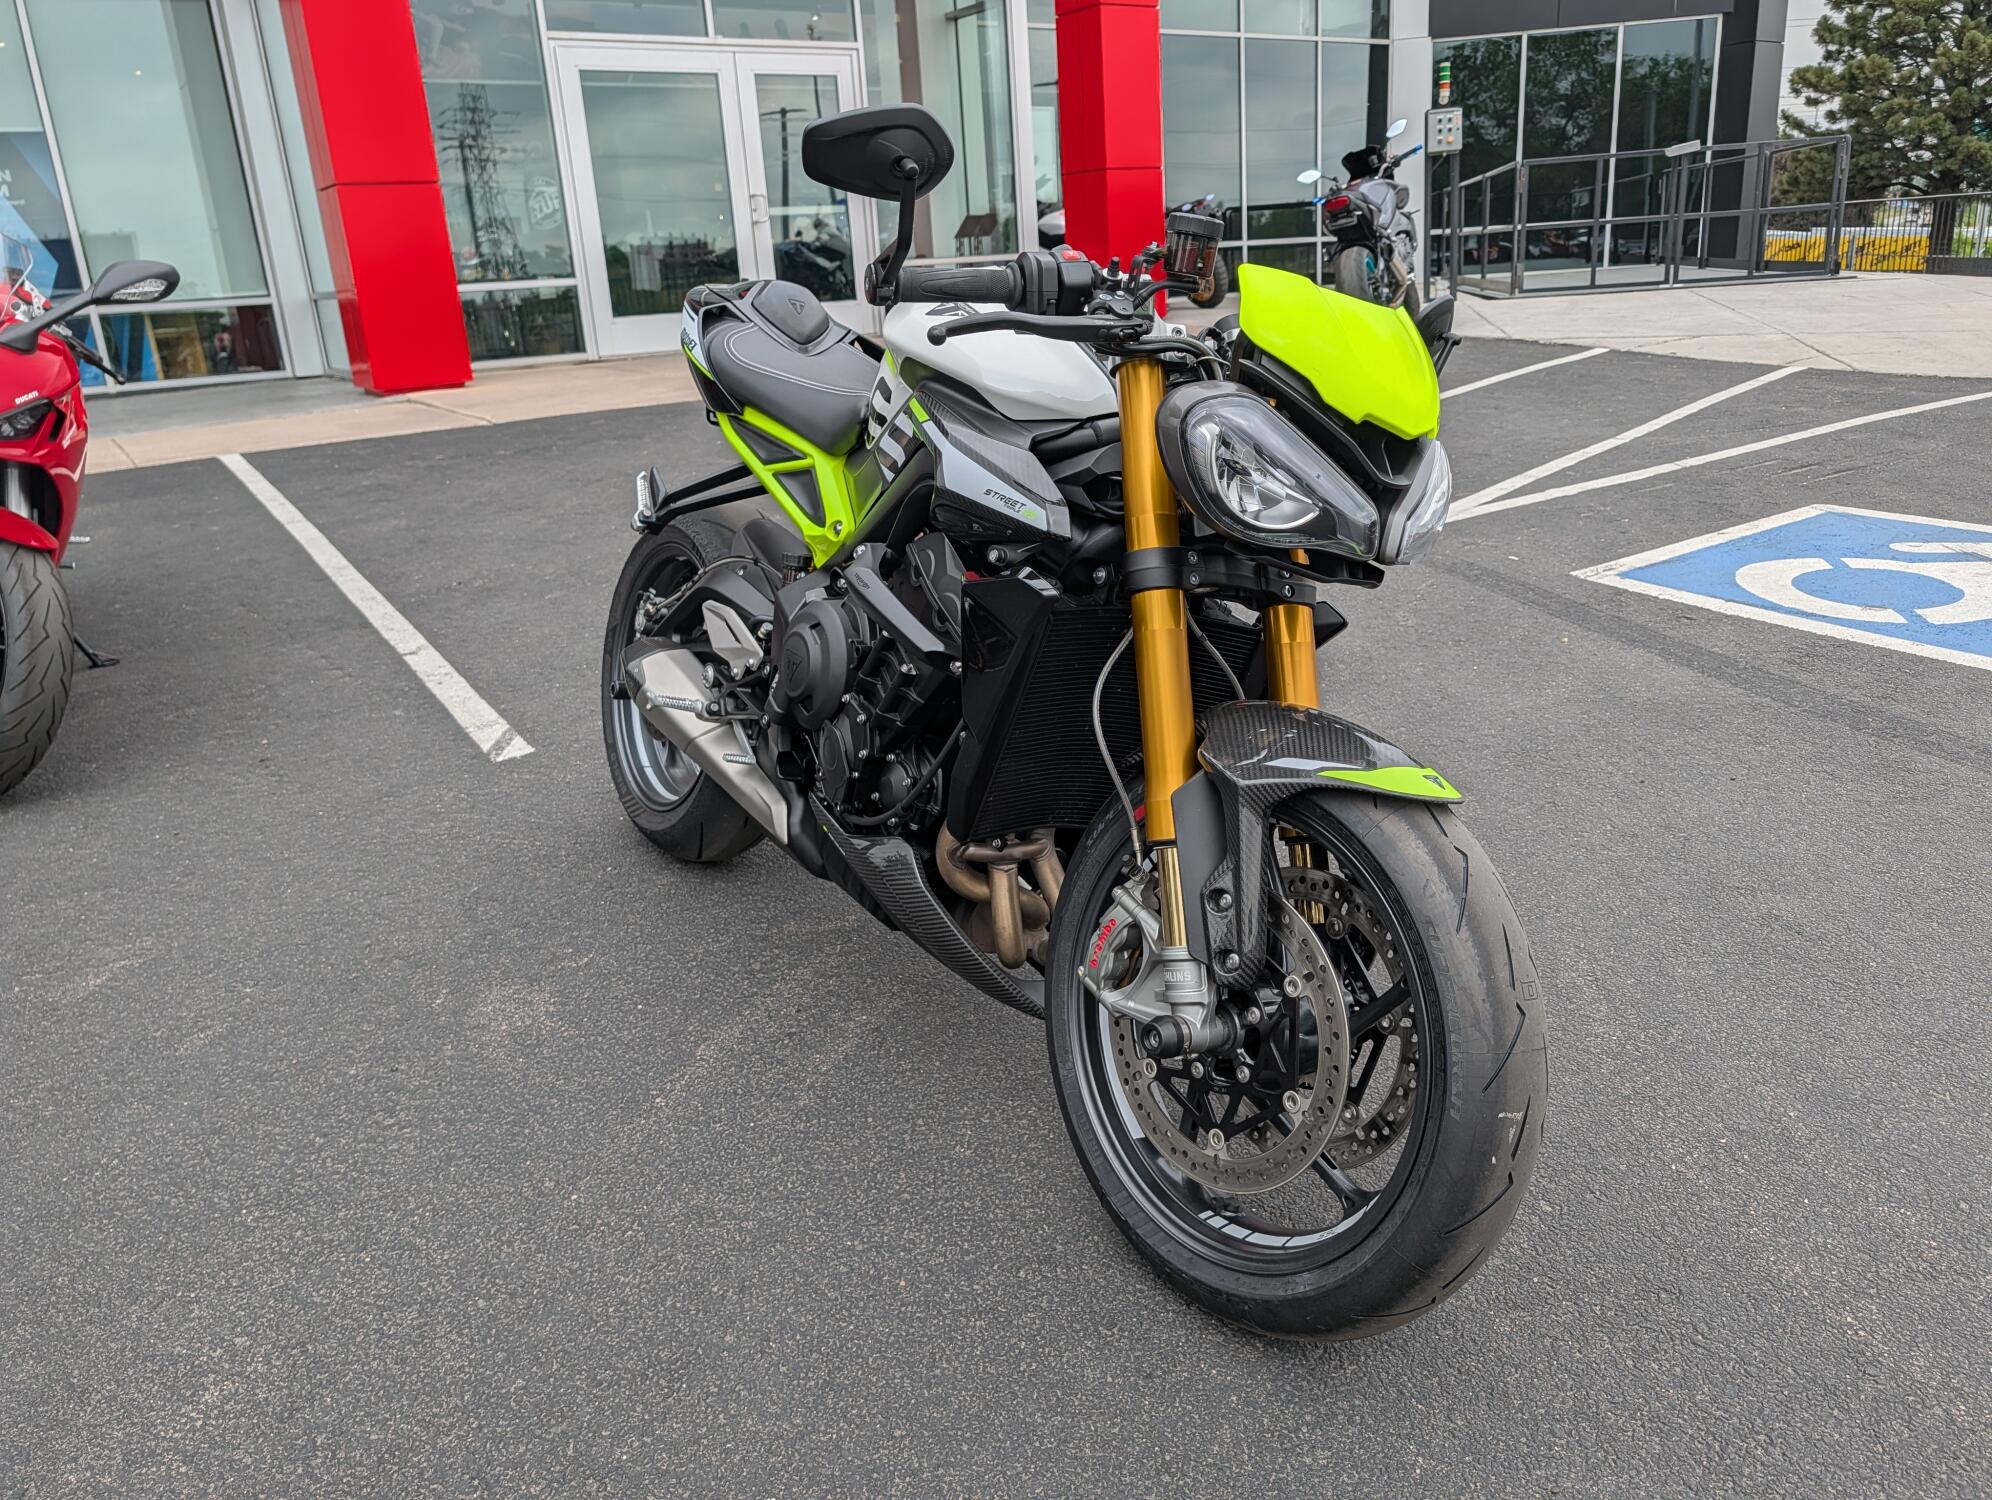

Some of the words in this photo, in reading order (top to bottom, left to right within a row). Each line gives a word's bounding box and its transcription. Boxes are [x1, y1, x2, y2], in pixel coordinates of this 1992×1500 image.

[14, 390, 39, 405] DUCATI
[983, 489, 1027, 510] STREET
[1089, 918, 1117, 969] brembo
